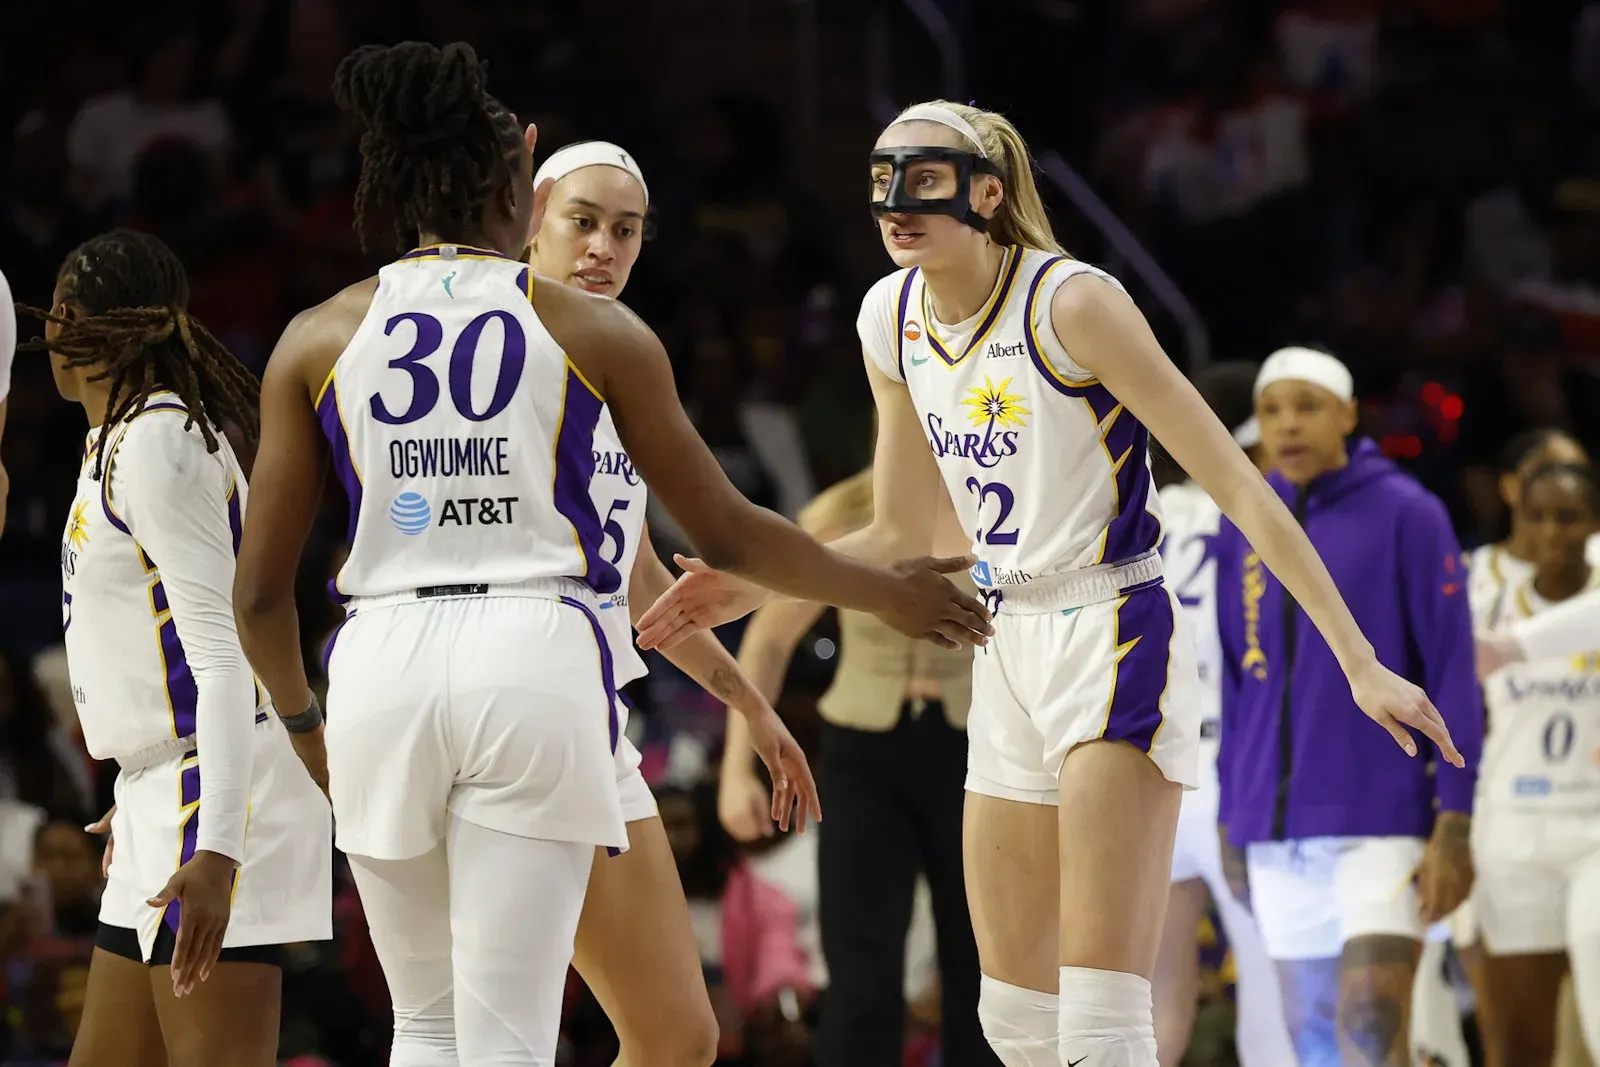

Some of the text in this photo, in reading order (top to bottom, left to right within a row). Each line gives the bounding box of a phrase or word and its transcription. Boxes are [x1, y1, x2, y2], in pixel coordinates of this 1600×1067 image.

[370, 309, 526, 424] 30
[987, 341, 1025, 359] Albert
[389, 437, 510, 479] OGWUMIKE
[438, 497, 519, 527] AT&T
[603, 500, 630, 566] 5
[993, 566, 1033, 585] Health
[1543, 711, 1575, 764] 0
